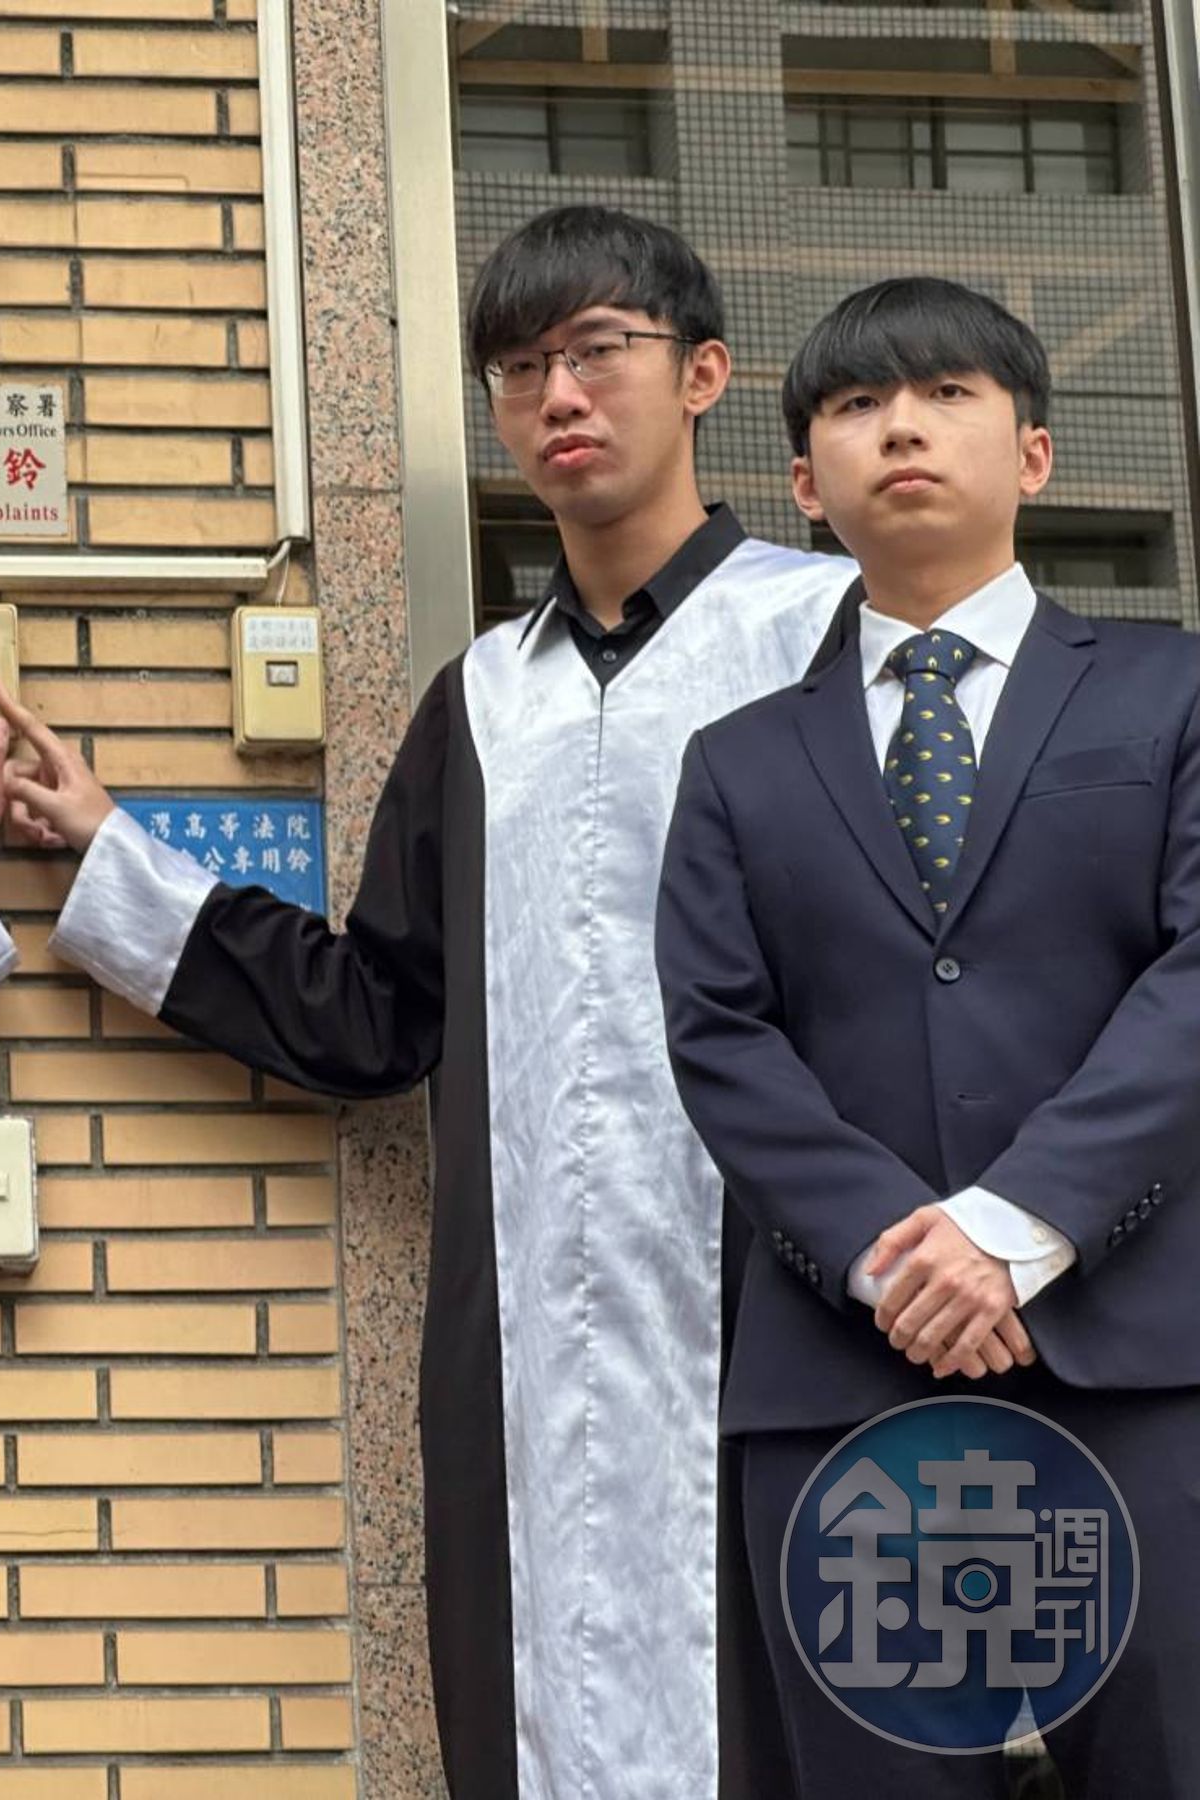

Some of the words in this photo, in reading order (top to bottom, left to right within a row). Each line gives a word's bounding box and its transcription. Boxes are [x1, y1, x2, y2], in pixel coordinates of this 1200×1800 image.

[16, 423, 57, 437] Office
[182, 846, 312, 874] 公專用鈴
